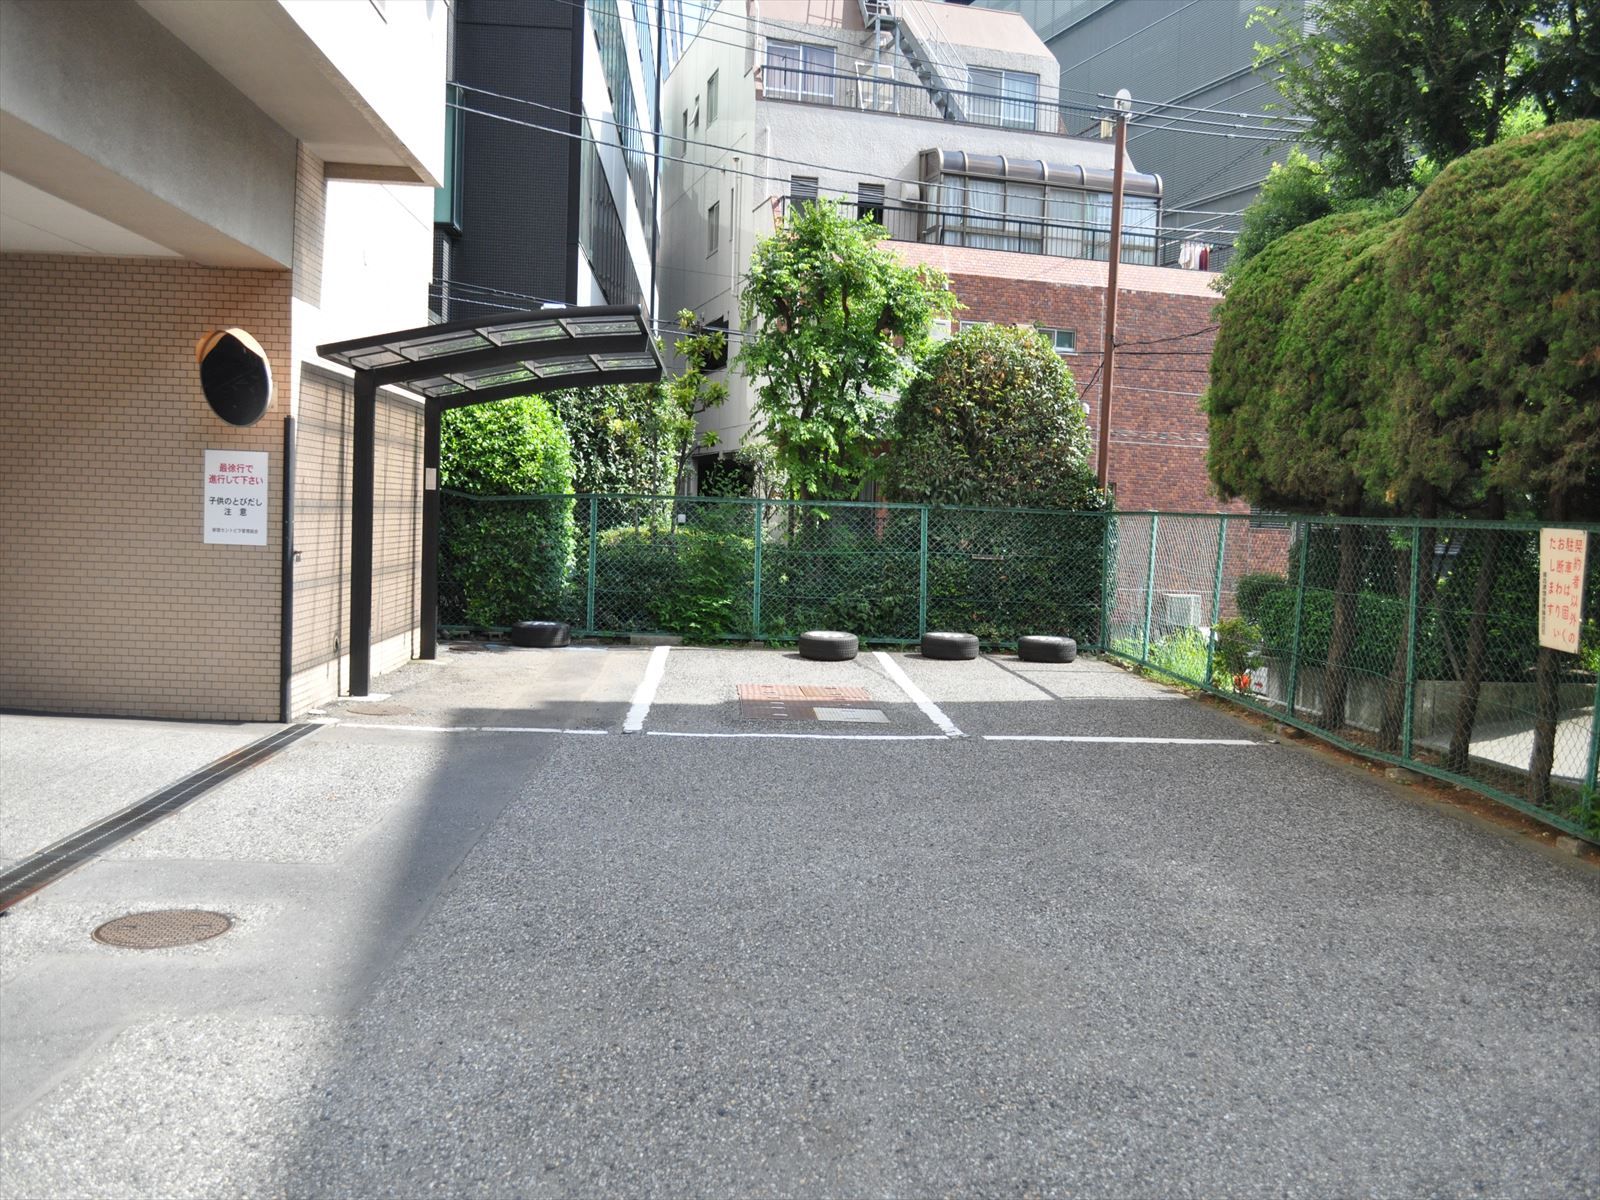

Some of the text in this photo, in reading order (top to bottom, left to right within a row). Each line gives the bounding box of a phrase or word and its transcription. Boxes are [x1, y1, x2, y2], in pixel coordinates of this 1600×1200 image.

[208, 474, 264, 485] 進行して下さい
[209, 496, 263, 507] 子供のとびだし
[1547, 537, 1556, 616] たします
[1561, 537, 1574, 643] 駐車は固く
[1568, 539, 1583, 643] 契約者以外の
